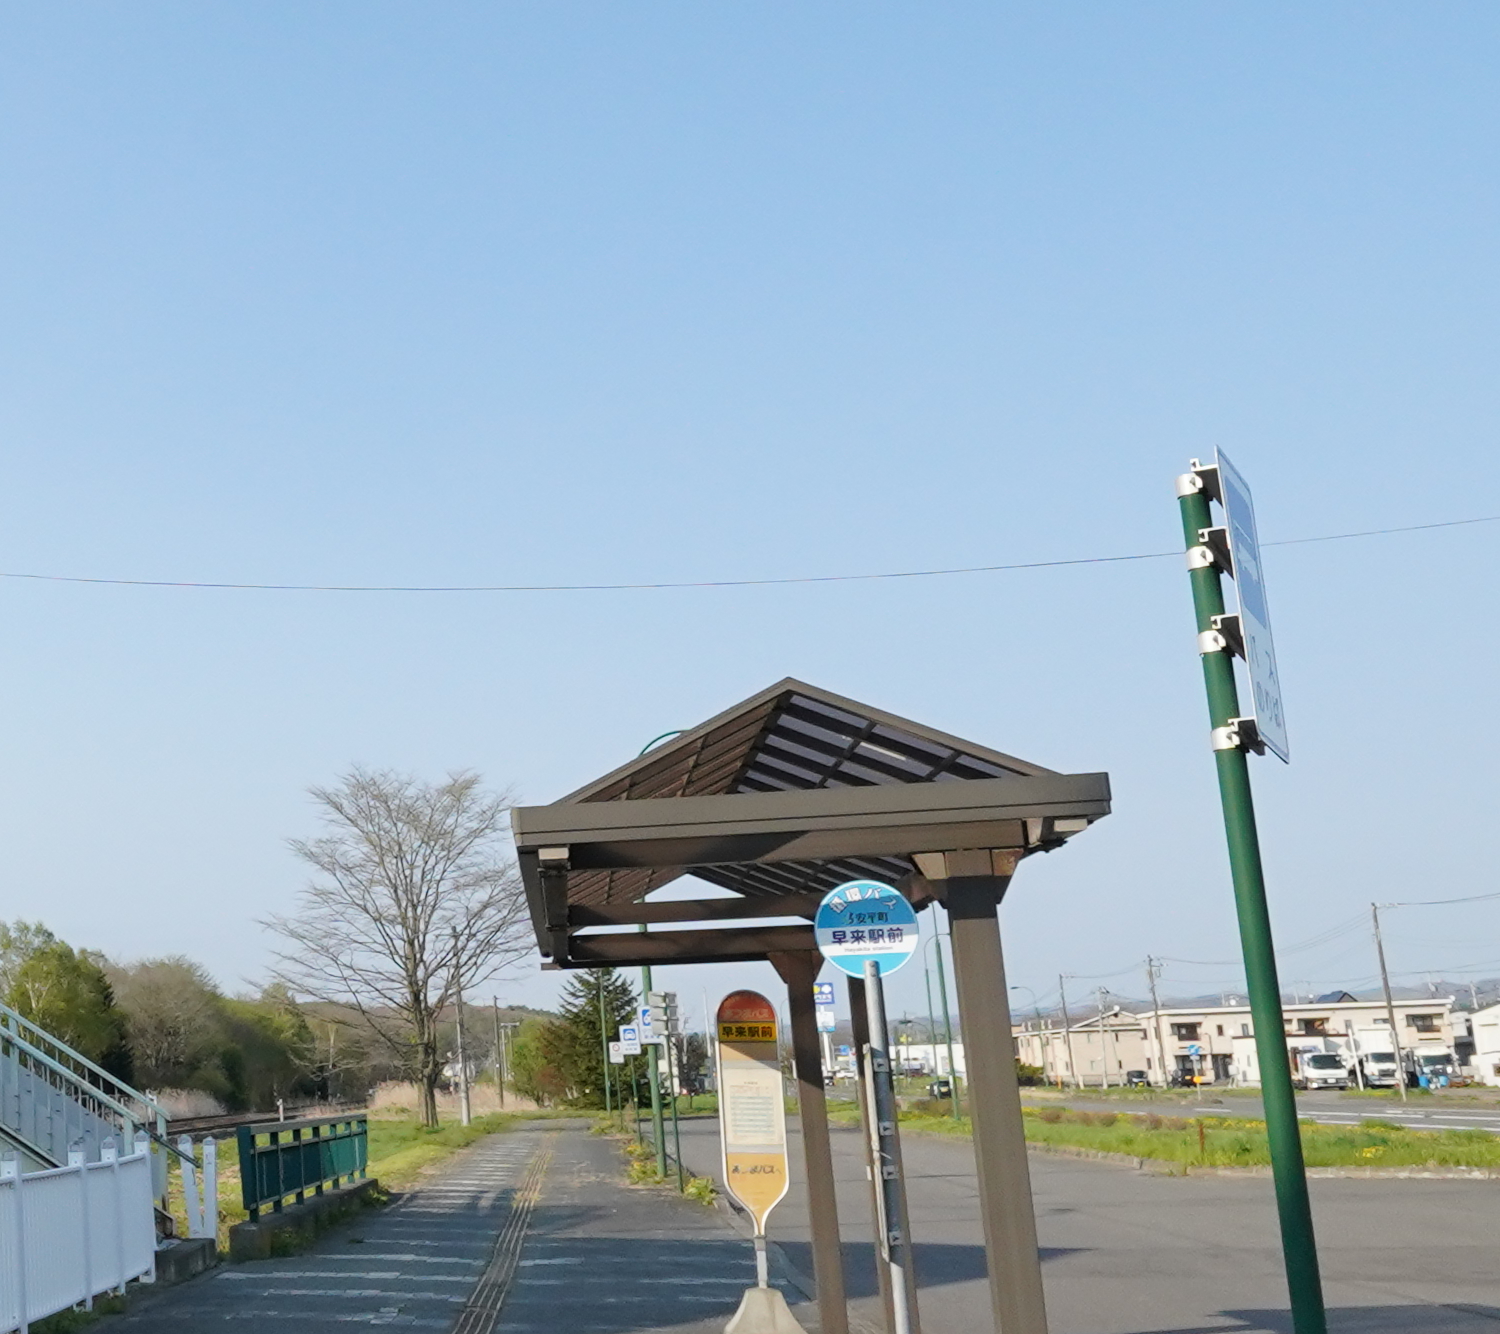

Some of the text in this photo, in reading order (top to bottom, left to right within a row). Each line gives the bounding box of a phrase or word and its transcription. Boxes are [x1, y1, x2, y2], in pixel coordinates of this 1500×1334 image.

[831, 927, 904, 946] 早来駅前
[722, 1025, 773, 1038] 早来駅前
